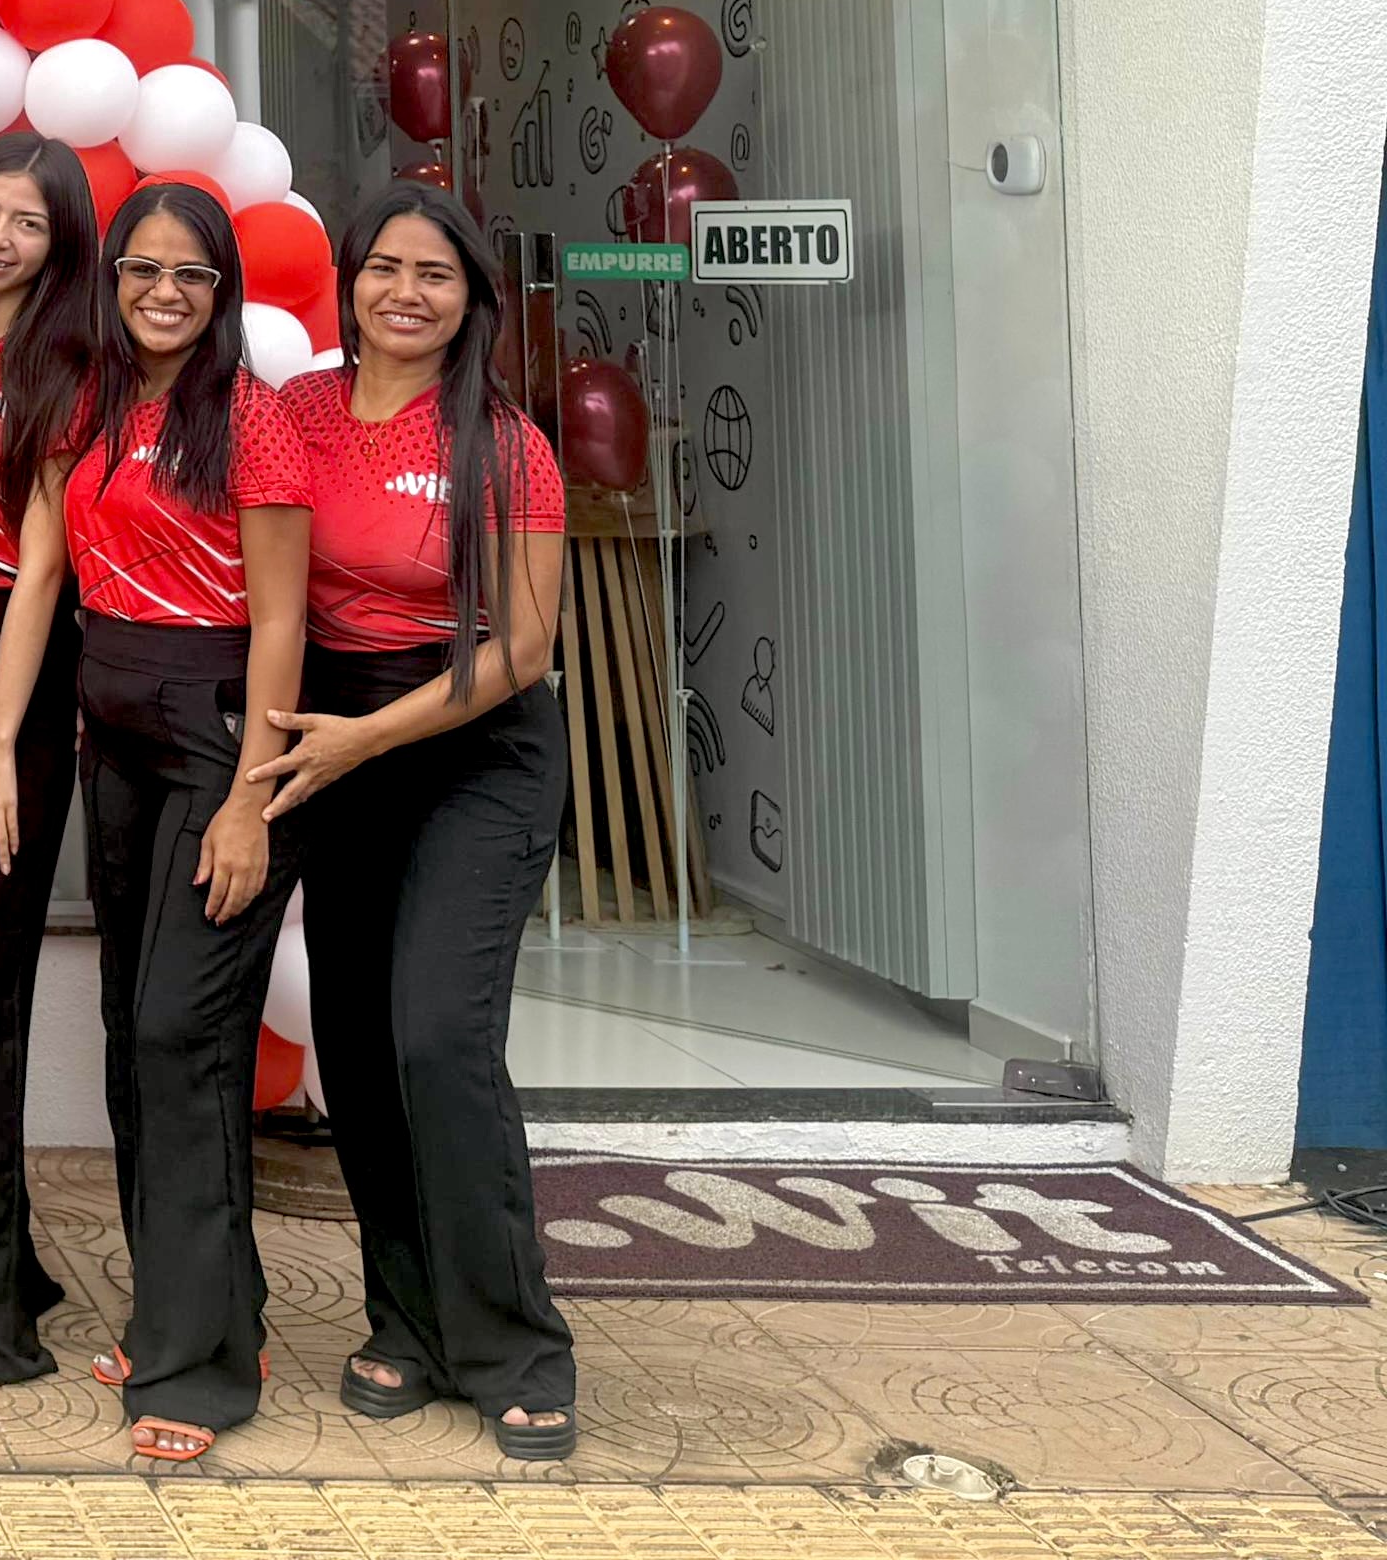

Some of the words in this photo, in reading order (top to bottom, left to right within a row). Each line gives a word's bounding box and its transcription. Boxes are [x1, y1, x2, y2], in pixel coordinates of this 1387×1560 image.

[703, 224, 841, 266] ABERTO
[567, 251, 684, 272] EMPURRE
[975, 1253, 1227, 1276] Telecom
